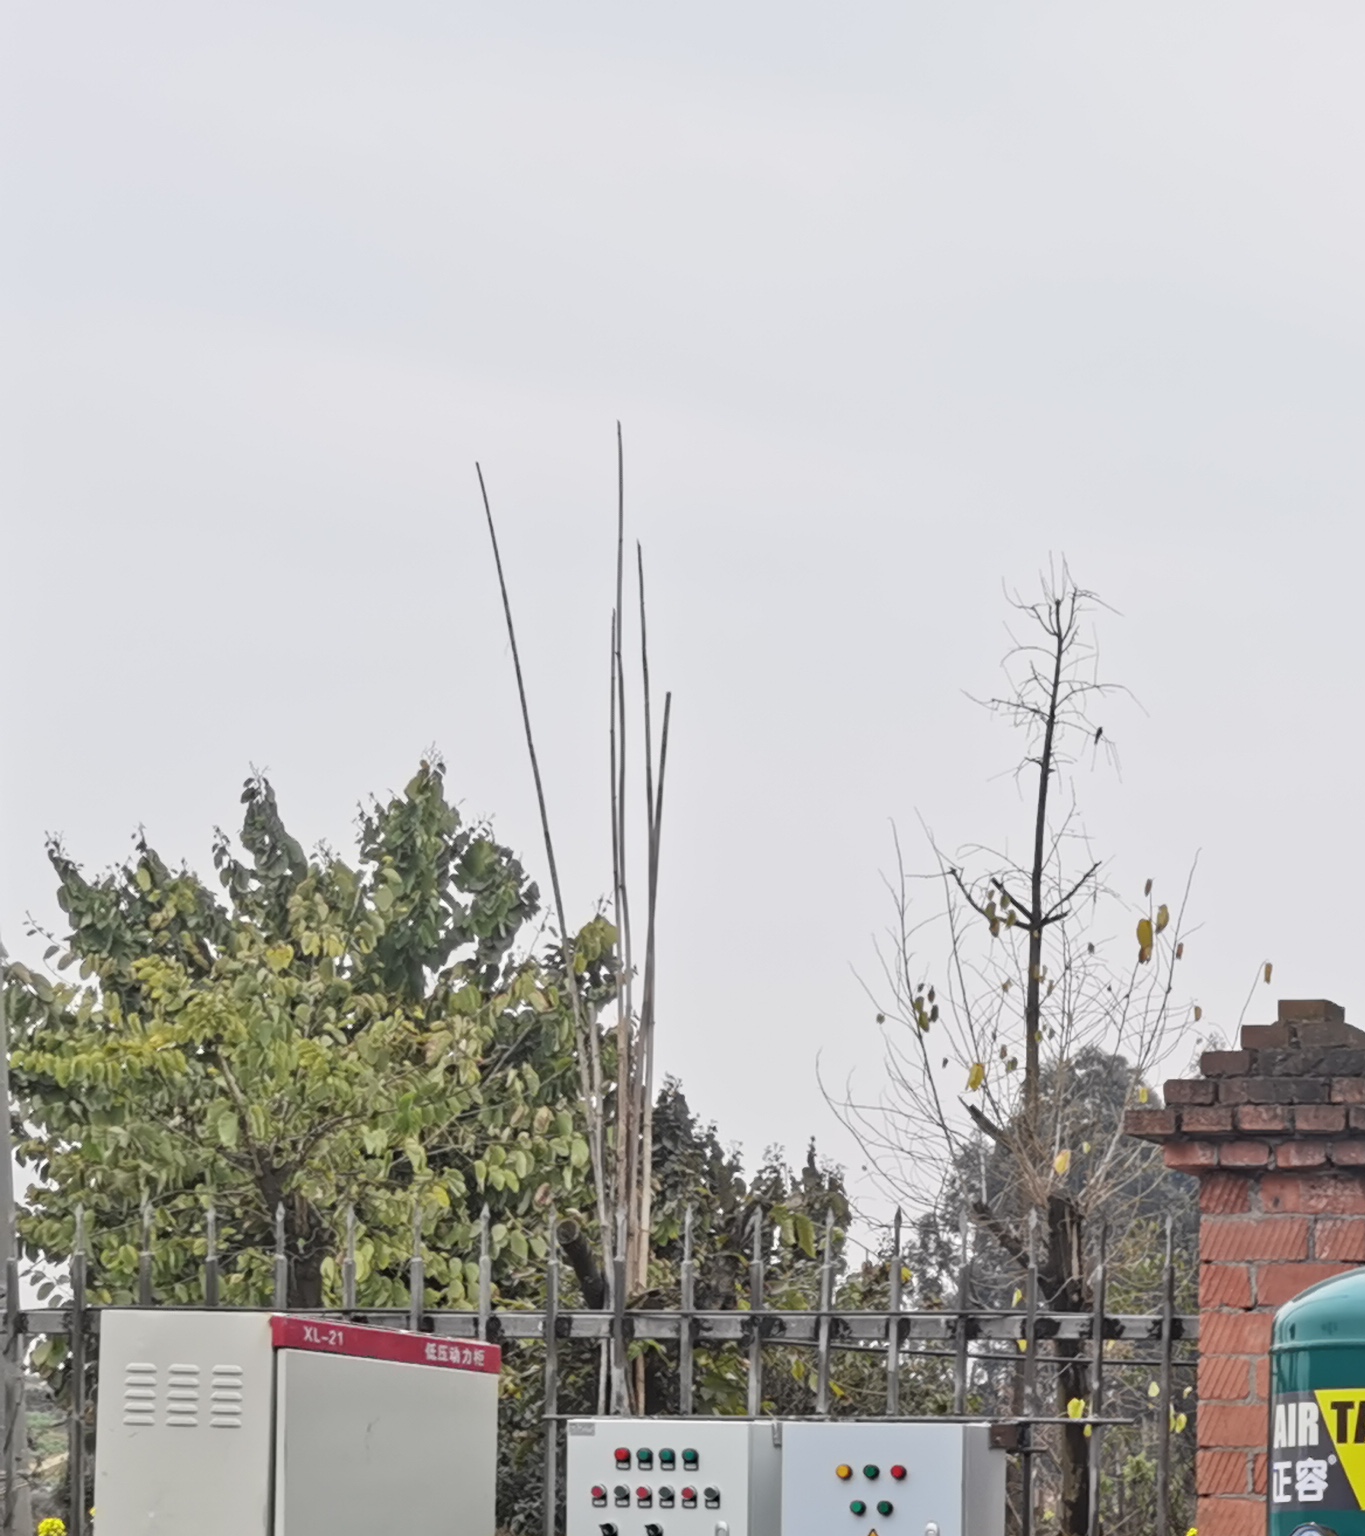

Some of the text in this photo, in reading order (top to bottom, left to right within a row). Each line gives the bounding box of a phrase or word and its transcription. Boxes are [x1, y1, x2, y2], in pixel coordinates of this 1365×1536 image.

[303, 1326, 344, 1346] XL-21
[425, 1342, 485, 1367] 低压动力柜
[1273, 1402, 1319, 1448] AIR
[1273, 1457, 1328, 1503] 正容
